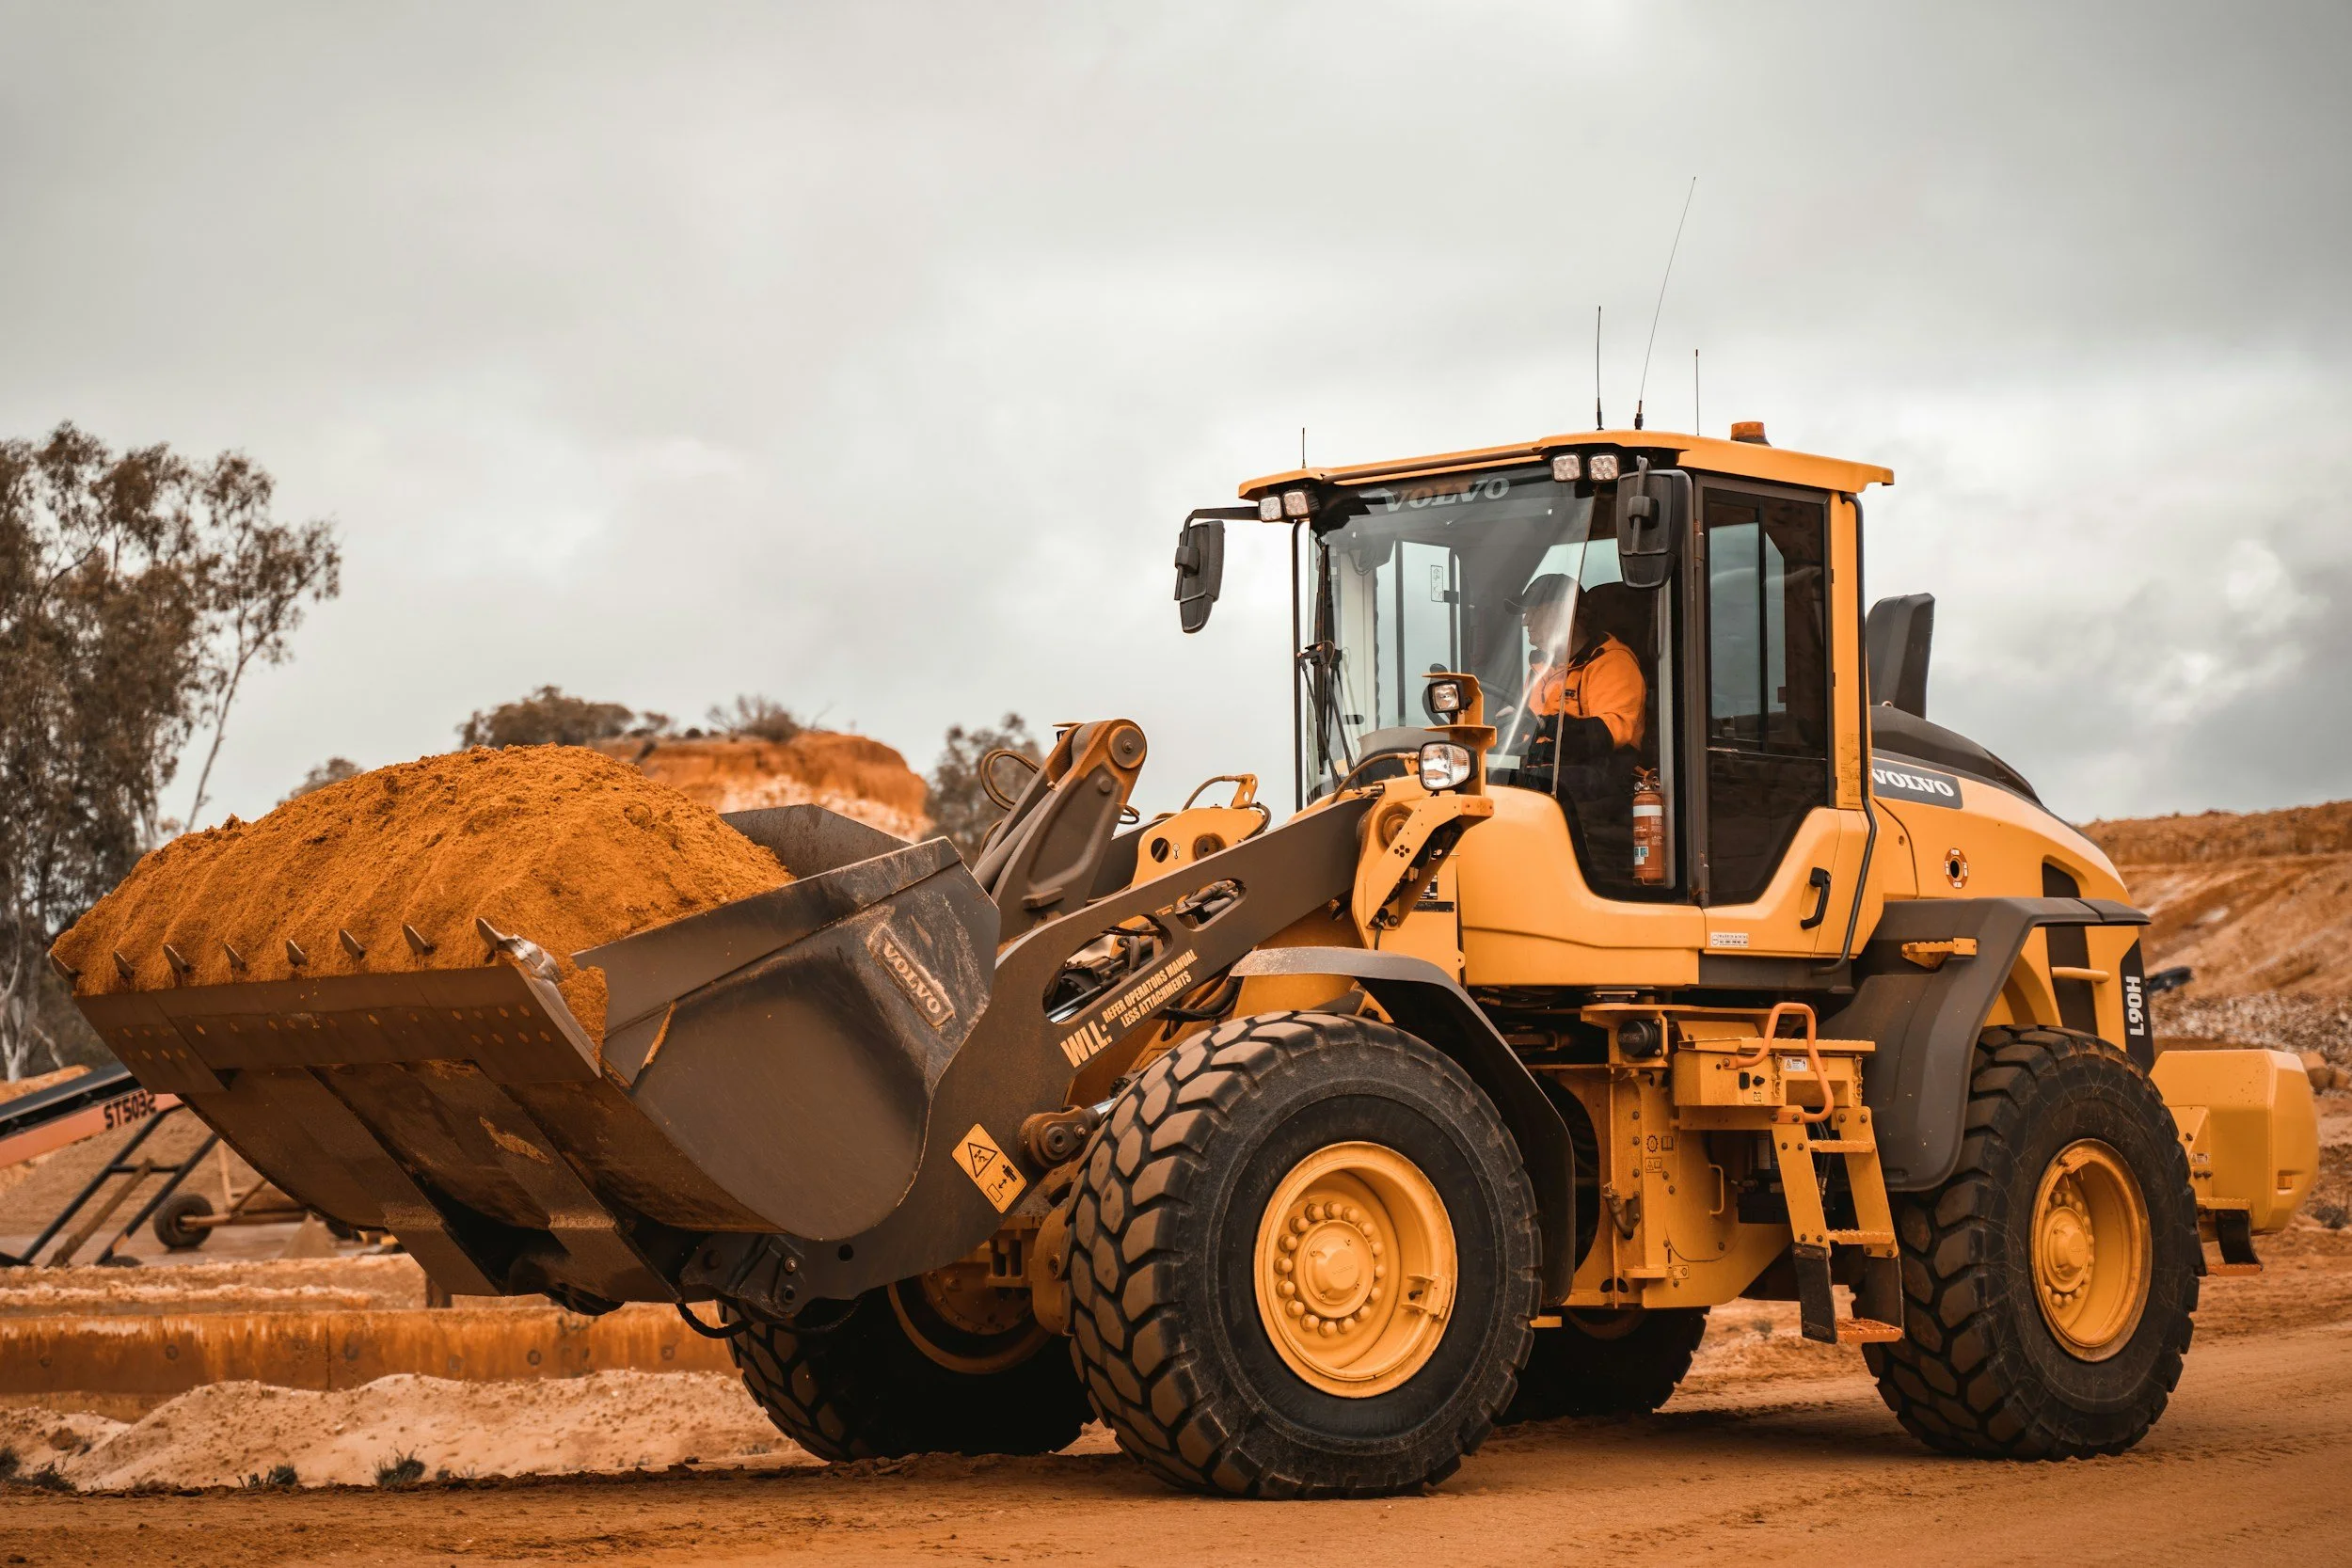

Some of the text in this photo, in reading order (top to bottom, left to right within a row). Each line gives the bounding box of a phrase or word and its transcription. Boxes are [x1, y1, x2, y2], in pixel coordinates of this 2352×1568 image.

[1380, 477, 1511, 513] VOLVO
[1871, 768, 1955, 798] VOLVO
[883, 937, 941, 1014] VOLVO
[1101, 949, 1199, 1024] REFER OPERATORS MANUAL
[1120, 970, 1192, 1029] LESS ATTACHMENTS
[2125, 975, 2145, 1037] L90H
[1059, 1020, 1113, 1069] WLL:
